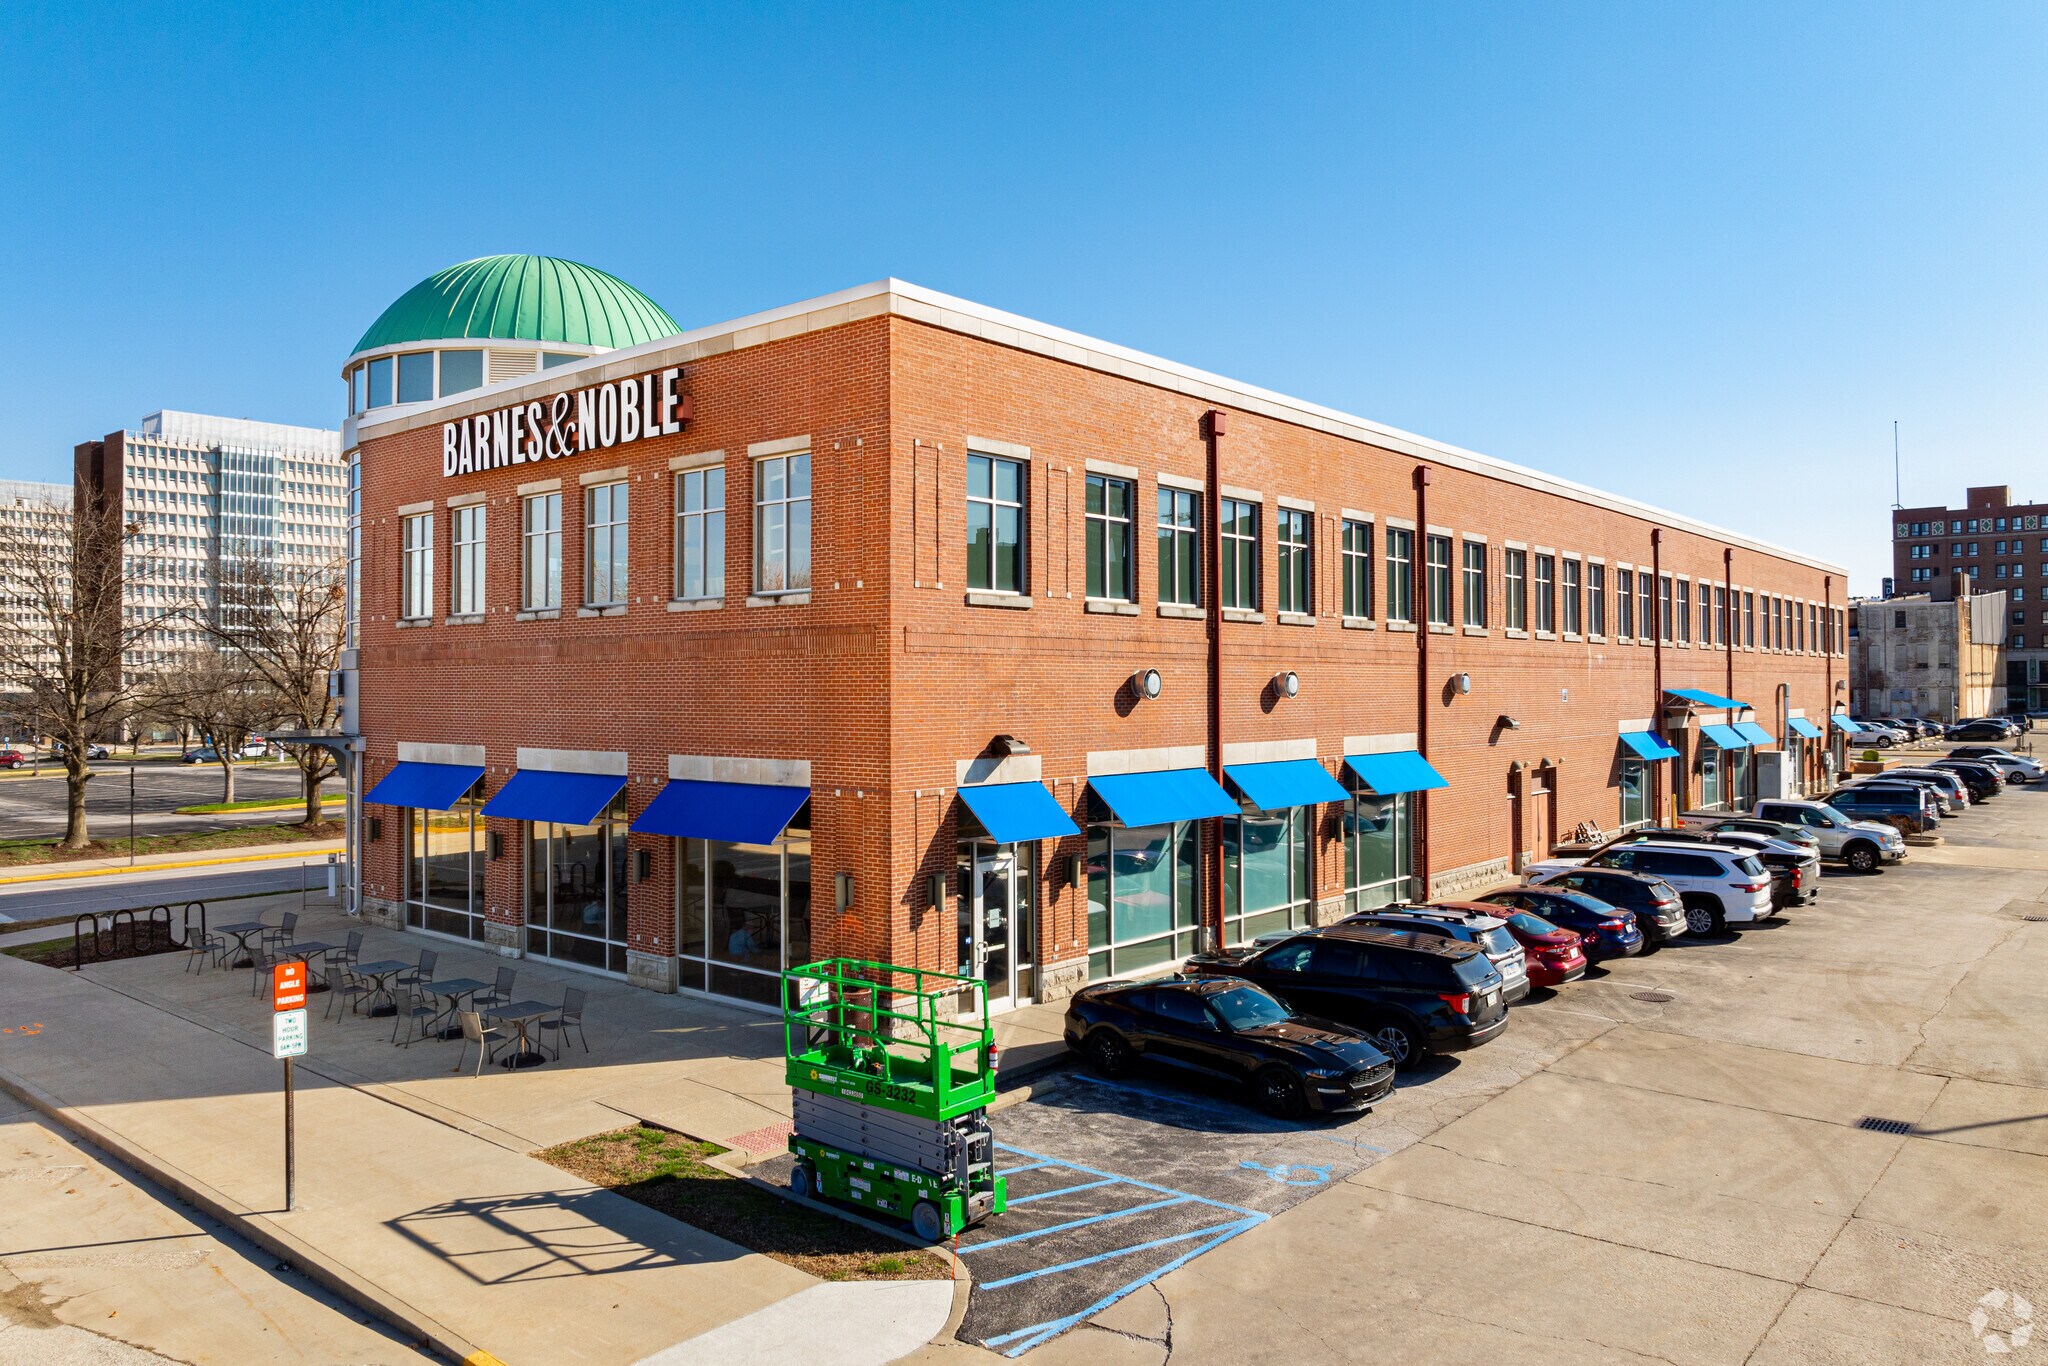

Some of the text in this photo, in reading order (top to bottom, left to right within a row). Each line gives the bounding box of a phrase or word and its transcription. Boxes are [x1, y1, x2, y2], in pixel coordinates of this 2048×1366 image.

[285, 968, 295, 976] NO
[279, 979, 300, 989] ANGLE
[276, 994, 304, 1005] PARKING
[282, 1025, 298, 1033] HOUR
[278, 1033, 303, 1042] PARKING
[865, 1080, 916, 1104] GS-3232
